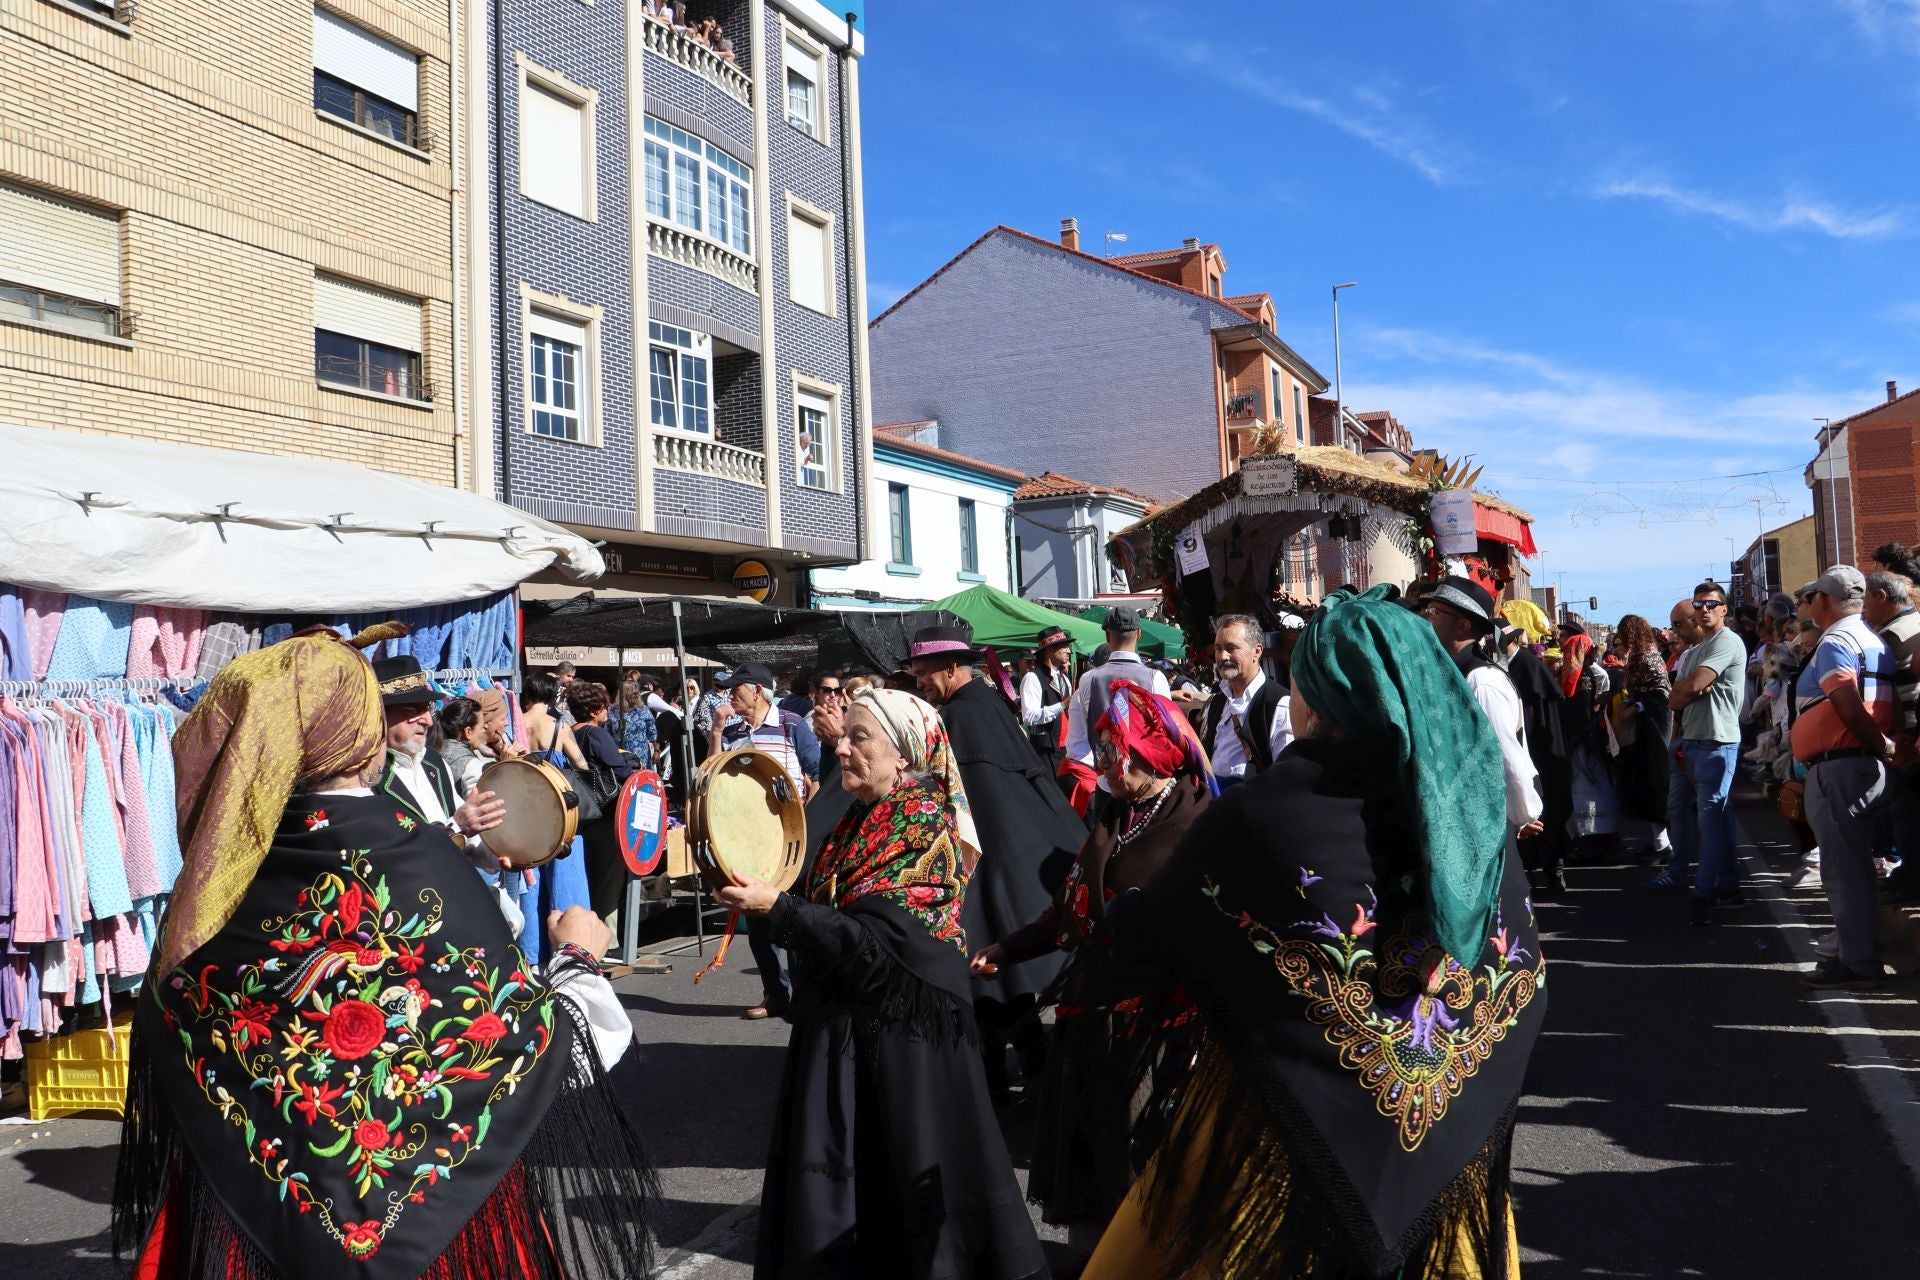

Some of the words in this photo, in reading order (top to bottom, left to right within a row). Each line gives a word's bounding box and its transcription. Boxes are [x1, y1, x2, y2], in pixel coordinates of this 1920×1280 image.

[1183, 537, 1198, 553] 9
[529, 649, 554, 660] Estrella
[554, 648, 577, 660] Galicia
